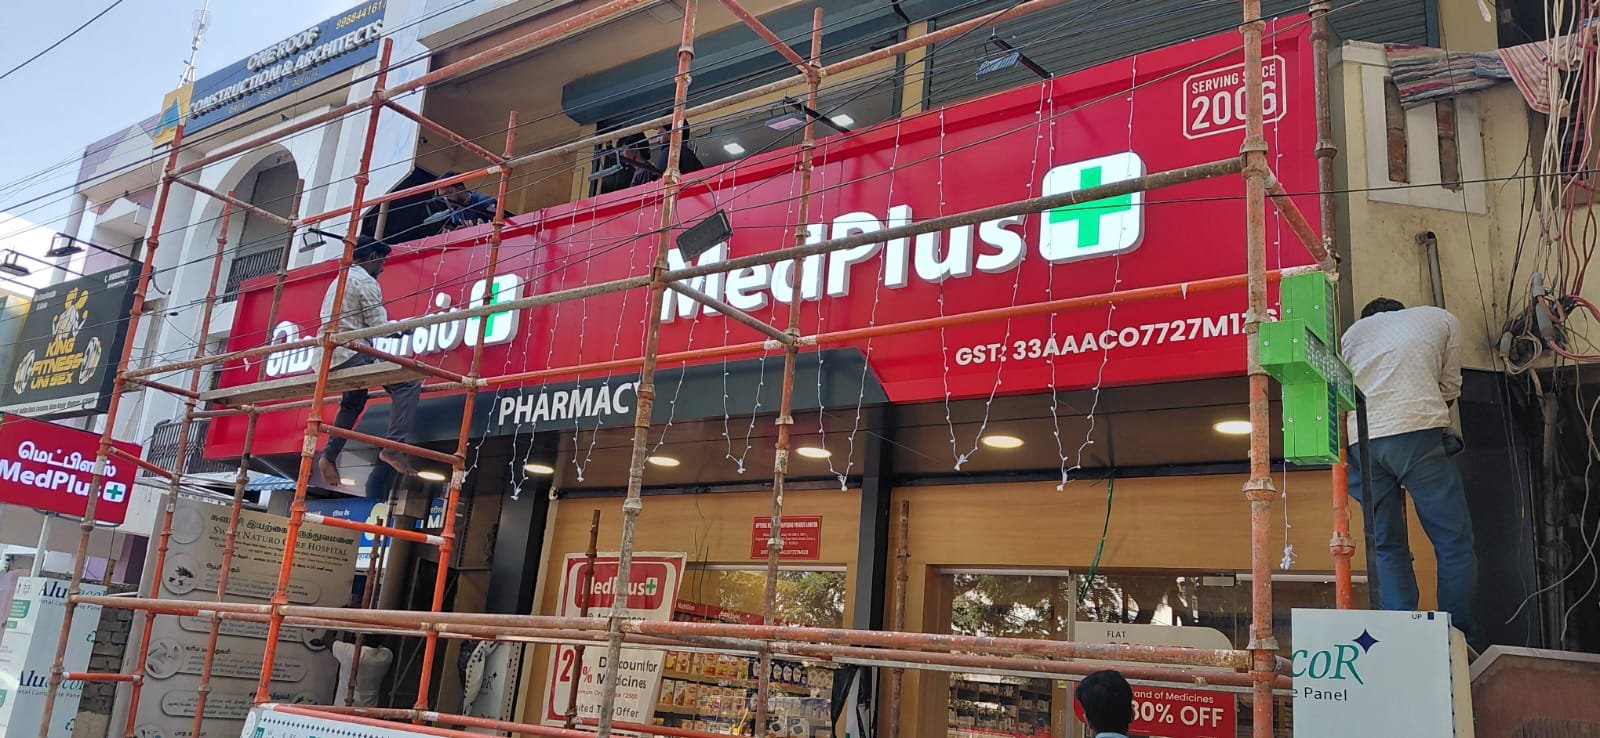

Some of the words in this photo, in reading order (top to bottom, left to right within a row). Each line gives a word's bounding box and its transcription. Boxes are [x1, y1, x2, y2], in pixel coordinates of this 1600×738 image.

[190, 67, 281, 114] CONSTRUCTION
[293, 18, 383, 70] ARCHITECTS
[1191, 73, 1239, 94] SERVING
[1242, 63, 1276, 82] SCE
[45, 337, 77, 358] KING
[31, 352, 84, 377] FITNESS
[242, 531, 280, 546] NATURO
[308, 541, 349, 556] HOSPITAL
[1106, 630, 1127, 639] FLAT
[598, 656, 645, 672] Dcount
[596, 672, 647, 689] Mdicines
[1154, 691, 1164, 700] of
[1166, 692, 1214, 704] Medicines
[1304, 687, 1347, 702] Panel
[616, 706, 639, 718] Offer
[1179, 705, 1224, 728] OFF
